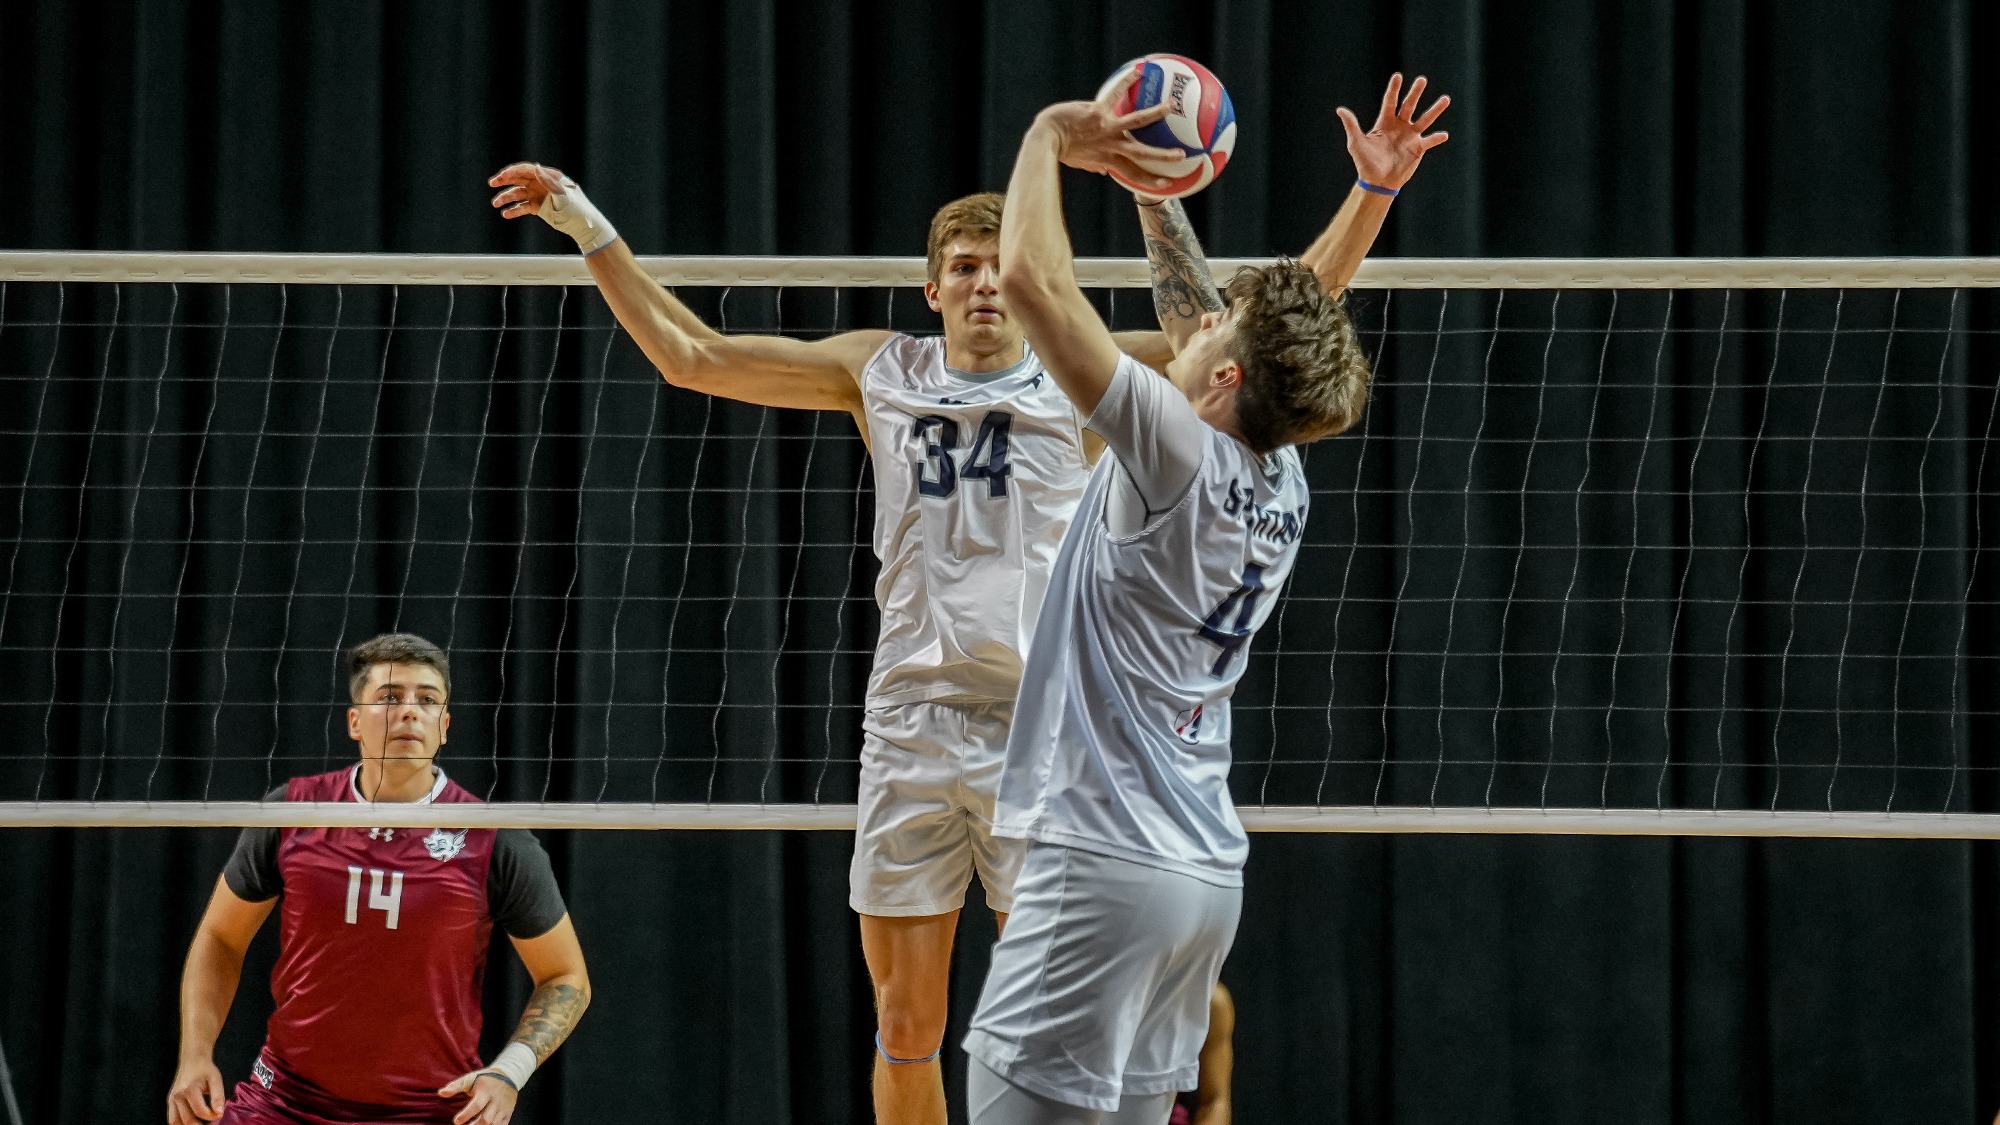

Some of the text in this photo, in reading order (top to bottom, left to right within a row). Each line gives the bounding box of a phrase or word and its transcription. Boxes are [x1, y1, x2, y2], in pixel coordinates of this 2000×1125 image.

[912, 410, 1015, 500] 34
[1195, 563, 1263, 680] 4
[344, 865, 405, 930] 14
